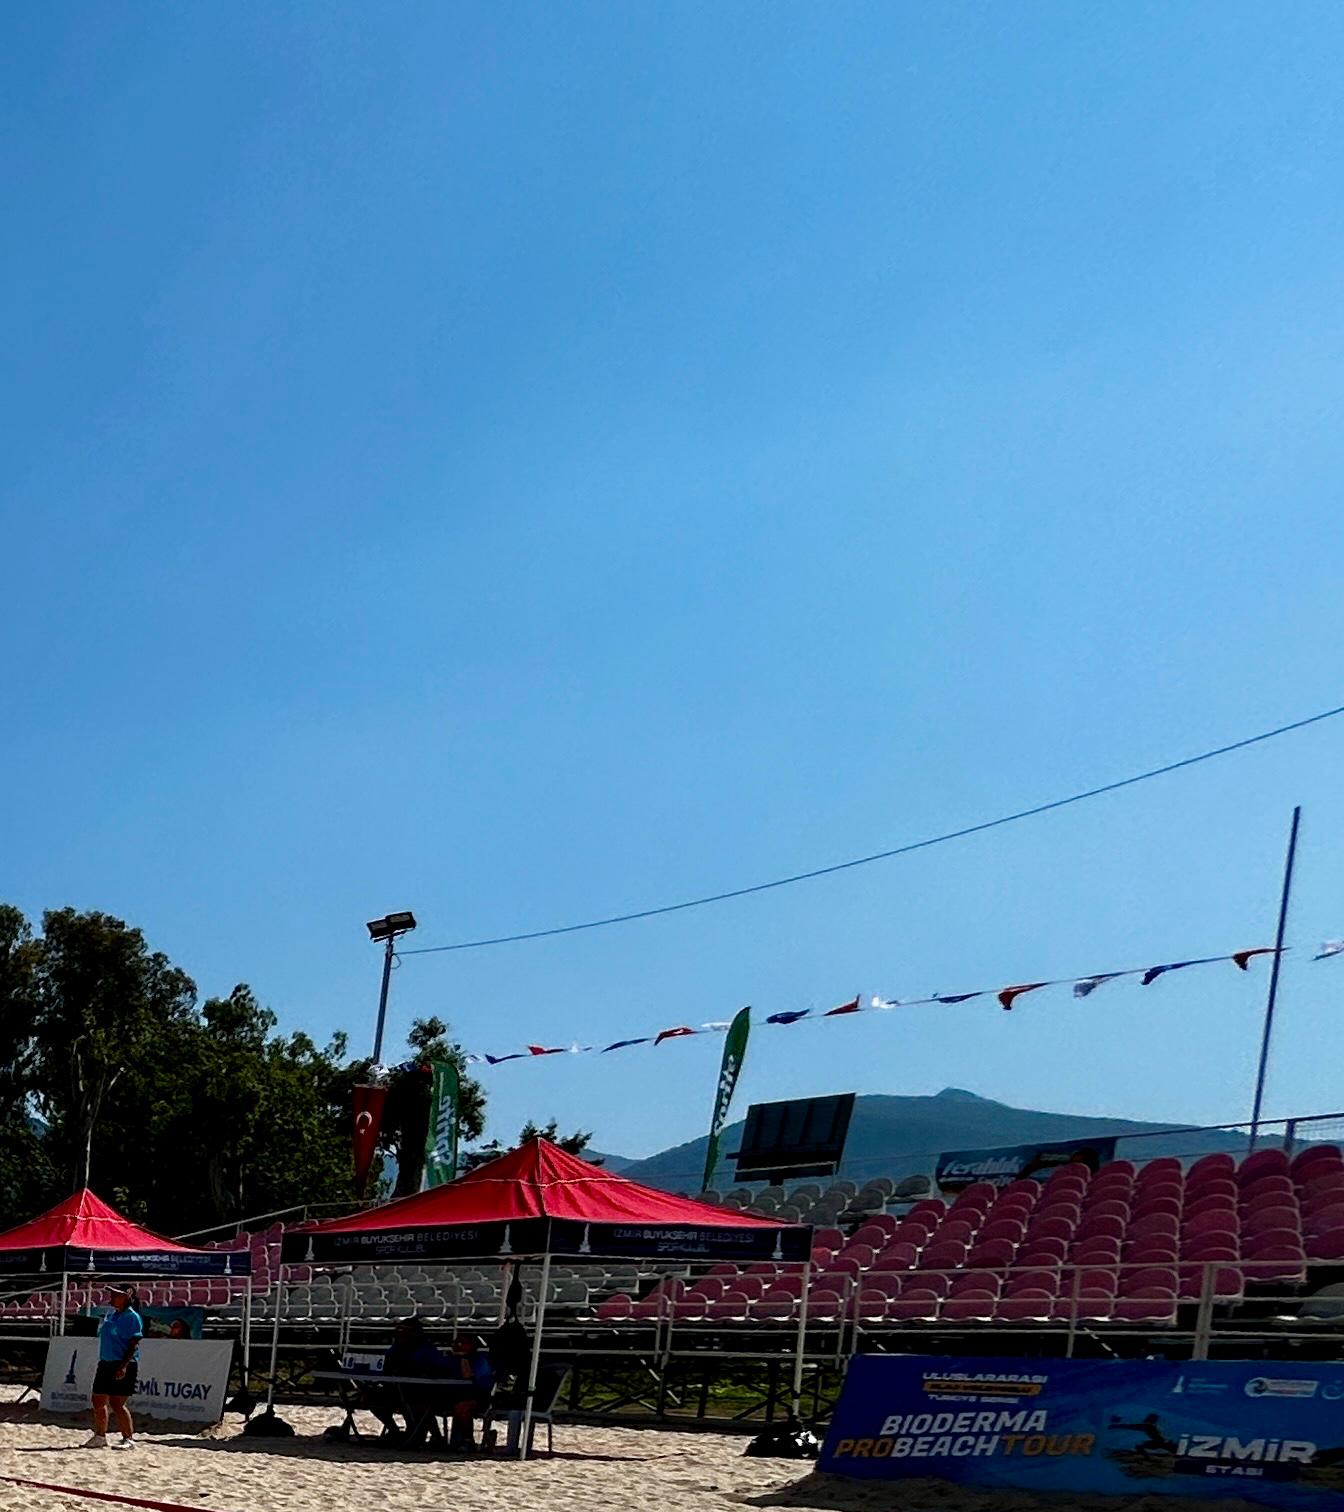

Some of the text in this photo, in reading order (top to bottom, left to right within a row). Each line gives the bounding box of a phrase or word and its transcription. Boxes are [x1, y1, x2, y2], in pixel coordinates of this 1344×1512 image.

[133, 1377, 211, 1400] EMİL TUGAY
[879, 1410, 1047, 1435] BIODERMA
